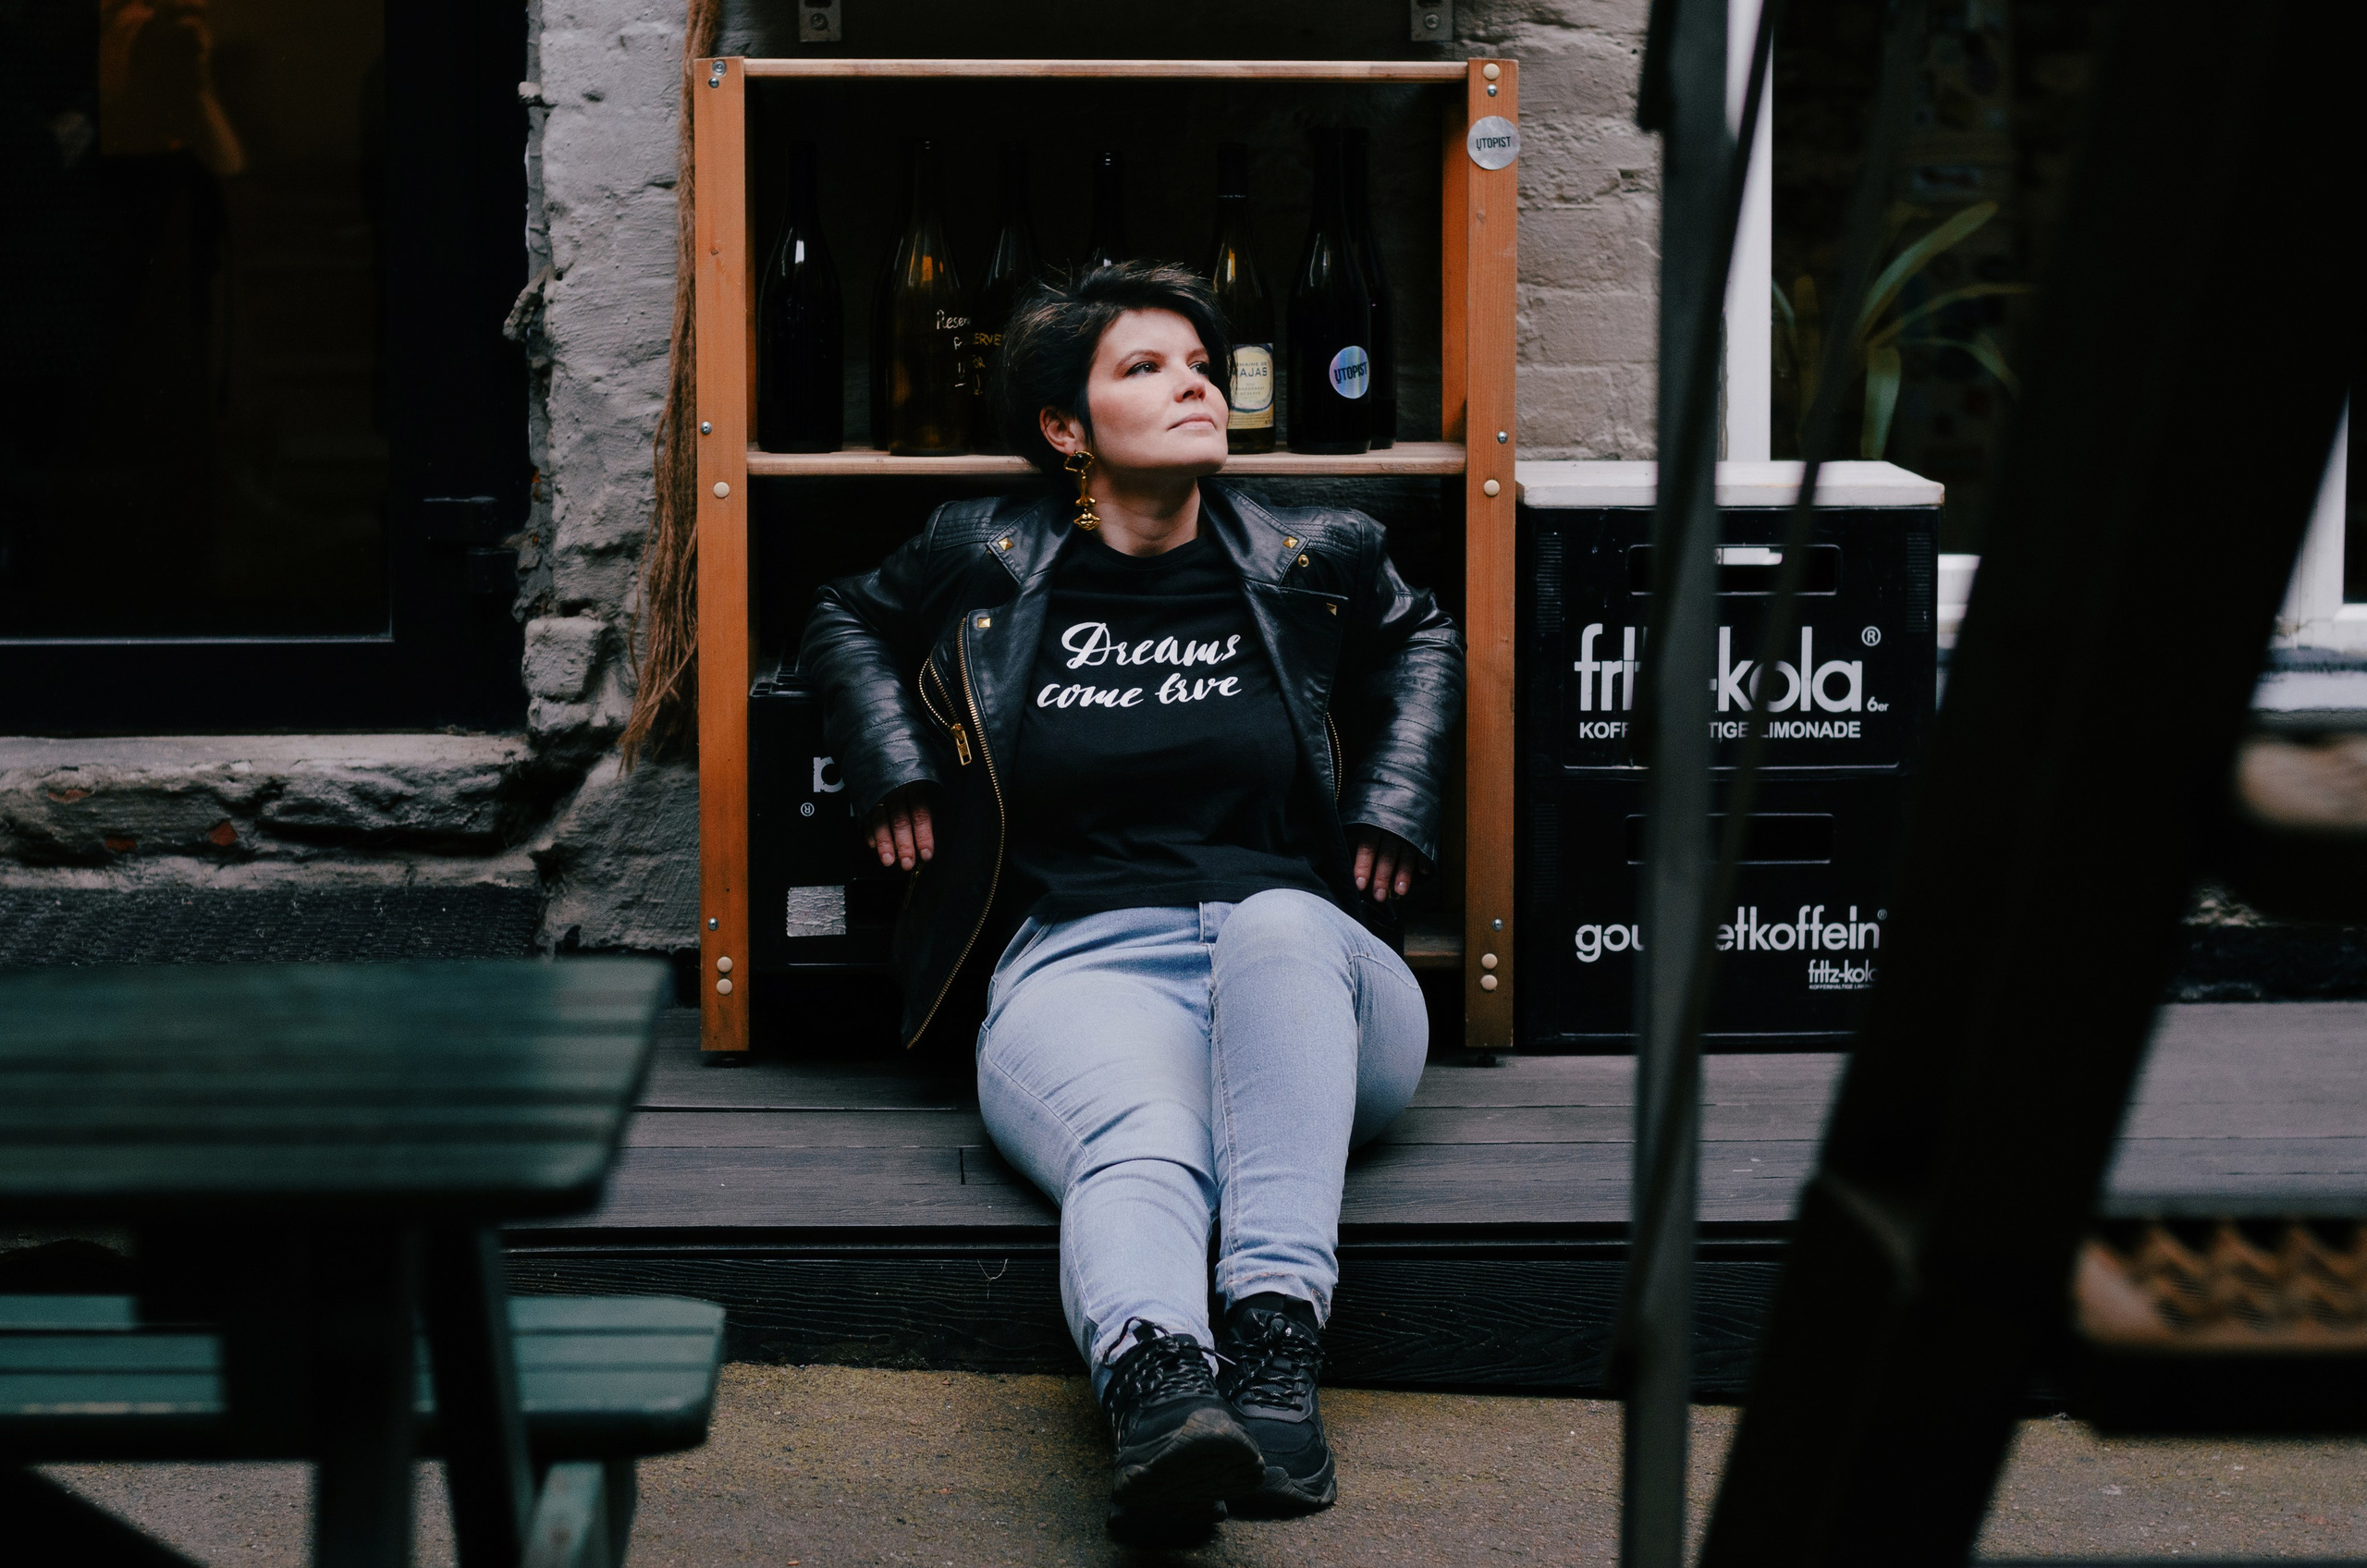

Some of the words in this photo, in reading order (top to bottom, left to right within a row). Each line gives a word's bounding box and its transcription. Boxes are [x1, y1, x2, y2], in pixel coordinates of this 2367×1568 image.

[1476, 136, 1511, 151] UTOPIST
[973, 333, 1002, 347] ERVE
[1239, 366, 1268, 377] AJAS
[1333, 361, 1367, 385] UTOPIST
[1061, 621, 1241, 669] Dreams
[1036, 682, 1144, 709] come
[1155, 672, 1242, 704] true
[1867, 695, 1890, 713] 6er
[1575, 904, 1881, 962] gouetkoffein
